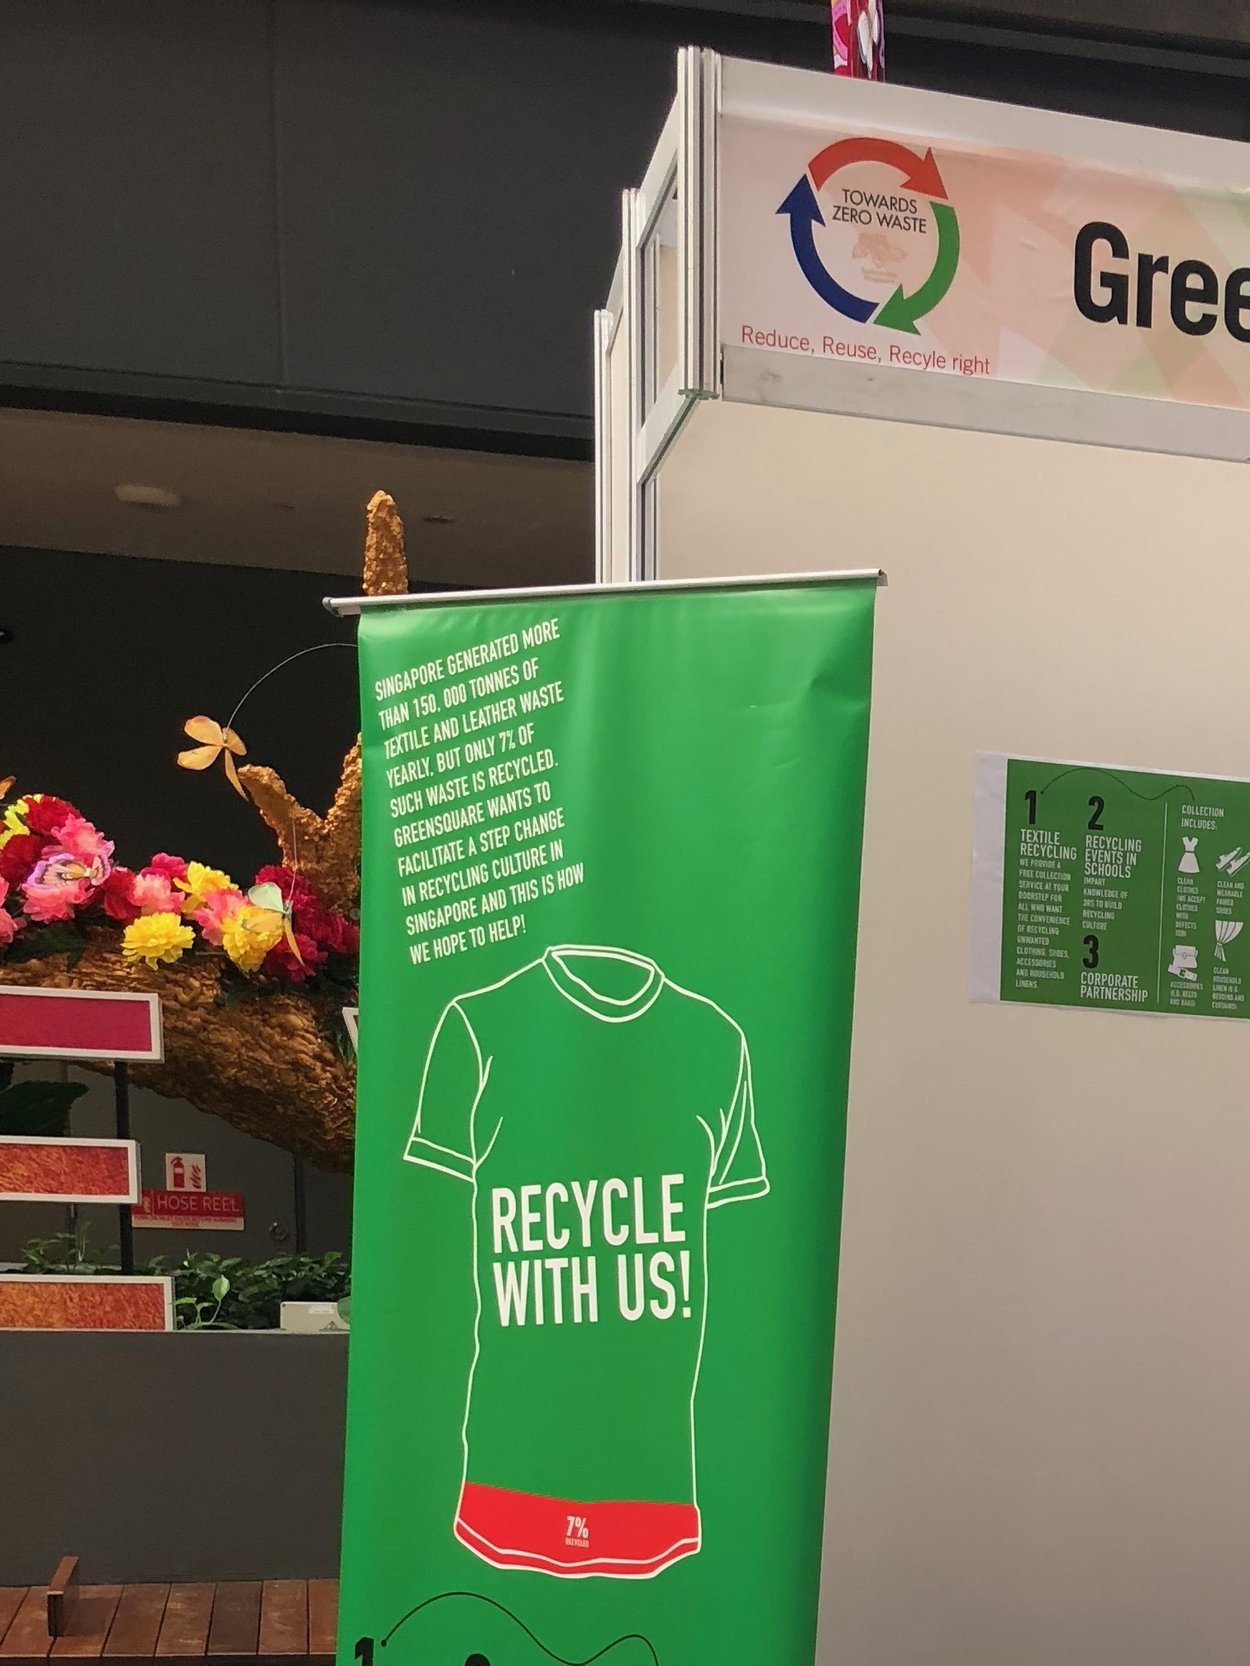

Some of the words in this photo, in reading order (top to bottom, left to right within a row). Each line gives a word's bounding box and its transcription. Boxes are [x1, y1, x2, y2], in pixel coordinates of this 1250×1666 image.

[832, 205, 872, 225] ZERO
[877, 212, 926, 233] WASTE
[842, 189, 917, 214] TOWARDS
[742, 325, 815, 354] Reduce,
[823, 336, 881, 363] Reuse,
[890, 345, 946, 370] Recyle
[952, 355, 990, 375] right
[375, 659, 445, 701] SINGAPORE
[447, 633, 519, 675] GENERATED
[522, 618, 560, 649] MORE
[379, 702, 409, 731] THAN
[444, 684, 466, 708] 000
[469, 665, 519, 700] TONNES
[523, 657, 539, 680] OF
[384, 726, 430, 759] TEXTILE
[434, 717, 459, 743] AND
[462, 698, 517, 733] LEATHER
[520, 681, 564, 714] WASTE
[437, 747, 460, 773] BUT
[465, 735, 495, 764] ONLY
[499, 729, 516, 752] 7%
[518, 723, 534, 746] OF
[390, 791, 423, 818] SUCH
[426, 779, 470, 809] WASTE
[473, 771, 485, 792] IS
[490, 749, 558, 788] RECYCLED.
[394, 802, 485, 847] GREENSQUARE
[487, 788, 531, 818] WANTS
[534, 781, 551, 803] TO
[1025, 790, 1037, 824] 1
[1088, 796, 1104, 831] 2
[1181, 805, 1224, 818] COLLECTION
[398, 839, 465, 877] FACILITATE
[468, 837, 477, 856] A
[480, 826, 510, 852] STEP
[515, 807, 565, 841] CHANGE
[1020, 829, 1060, 846] TEXTILE
[1020, 843, 1077, 861] RECYCLING
[1085, 835, 1142, 853] RECYCLING
[402, 886, 415, 906] IN
[419, 863, 488, 902] RECYCLING
[492, 845, 547, 879] CULTURE
[550, 839, 563, 861] IN
[1084, 863, 1131, 879] SCHOOLS
[1085, 849, 1122, 865] EVENTS
[1125, 852, 1137, 866] IN
[406, 897, 477, 936] SINGAPORE
[482, 889, 507, 915] AND
[510, 879, 538, 906] THIS
[542, 874, 554, 896] IS
[557, 862, 583, 891] HOW
[410, 942, 430, 965] WE
[433, 932, 467, 960] HOPE
[469, 926, 485, 946] TO
[489, 914, 526, 943] HELP!
[1083, 934, 1099, 969] 3
[1080, 986, 1148, 1003] PARTNERSHIP
[1081, 972, 1139, 987] CORPORATE
[158, 1196, 197, 1210] HOSE
[203, 1198, 240, 1212] REEL
[492, 1174, 685, 1253] RECYCLE
[493, 1256, 598, 1327] WITH
[617, 1250, 691, 1321] US!
[567, 1516, 589, 1539] 7%
